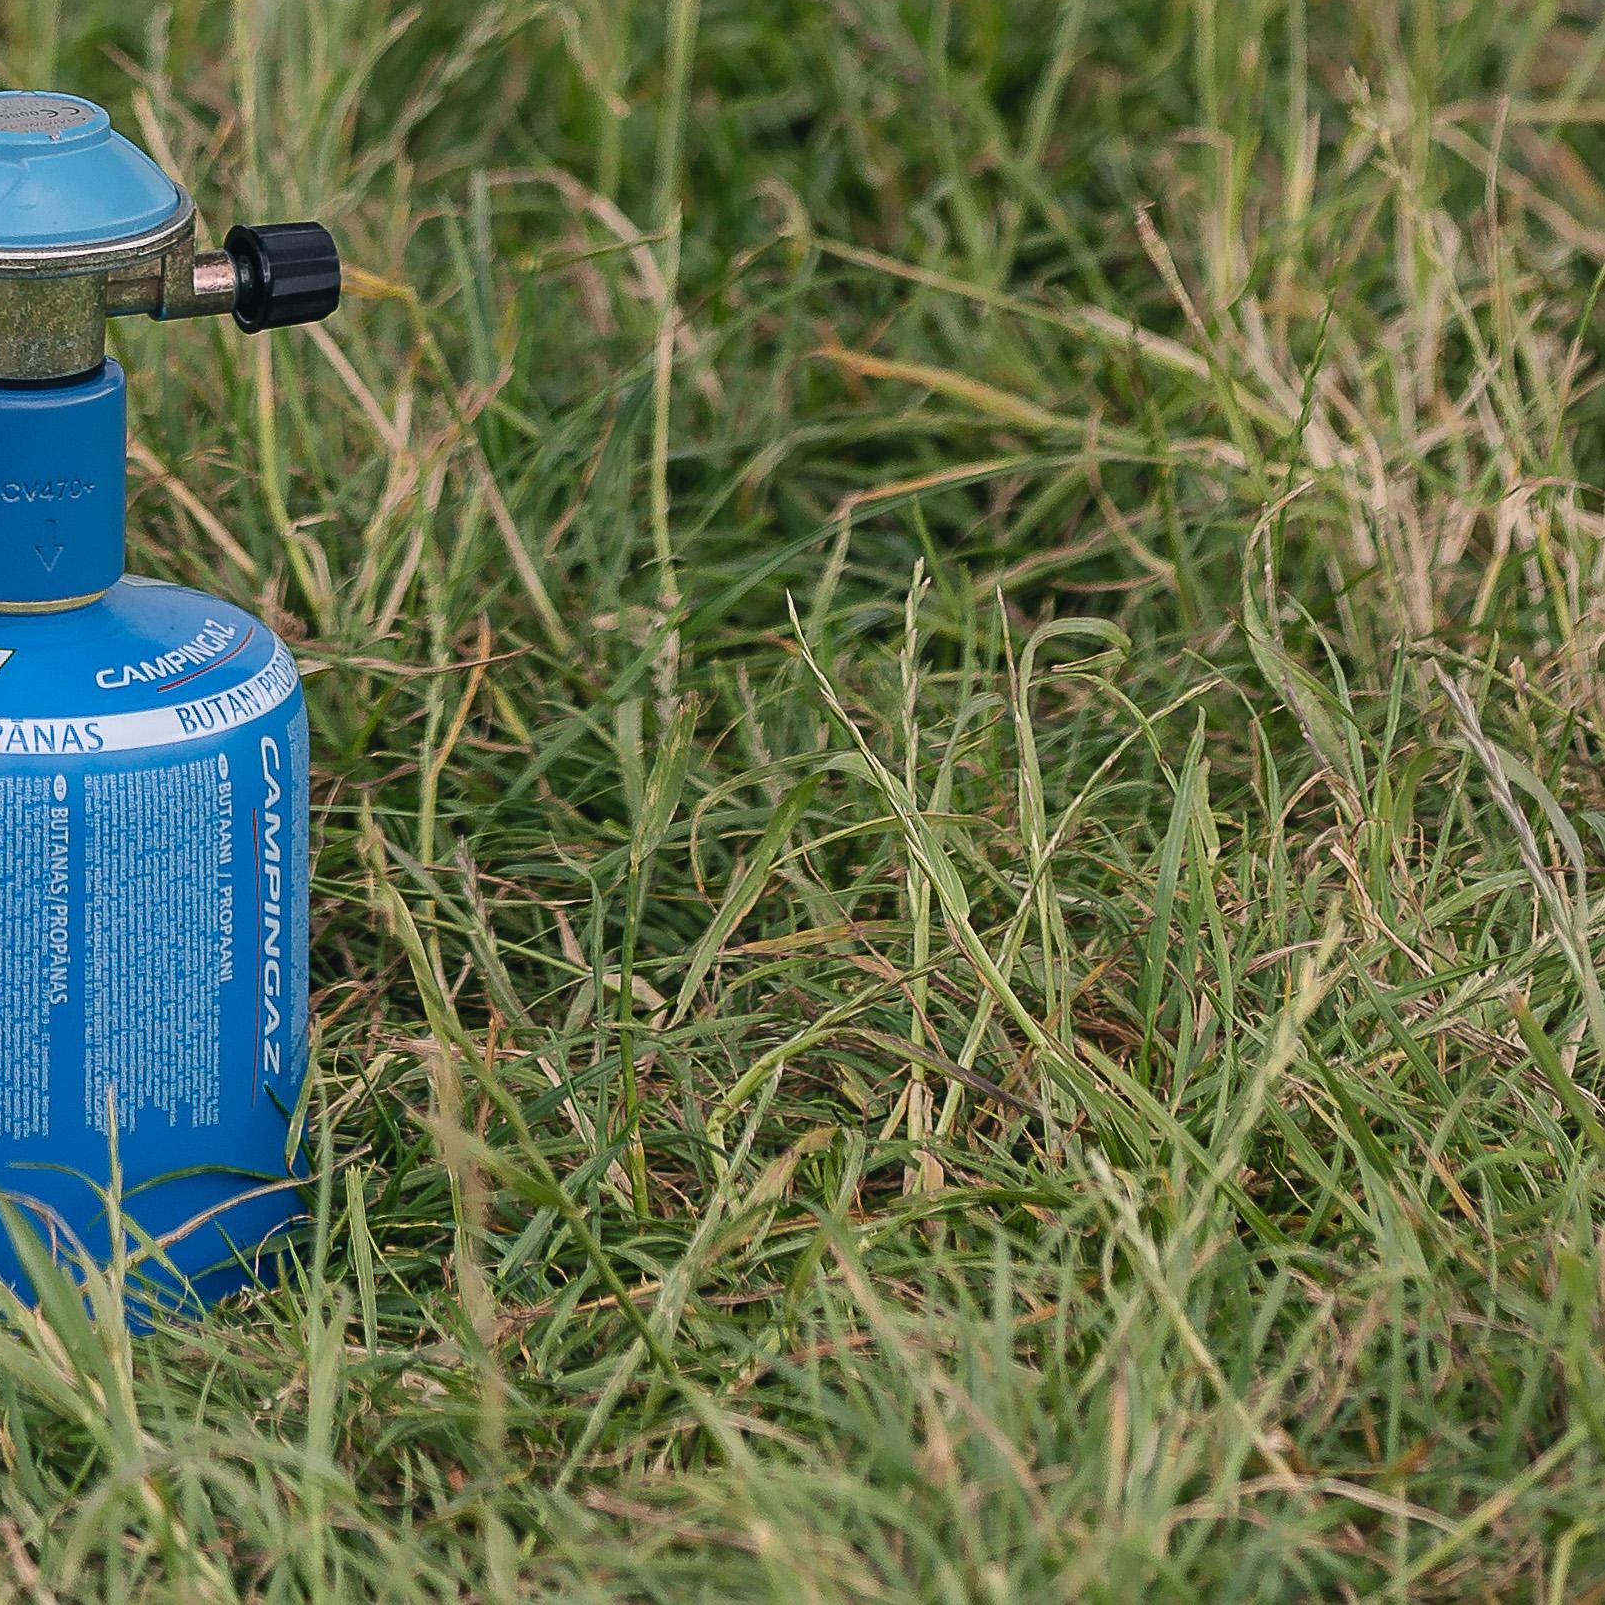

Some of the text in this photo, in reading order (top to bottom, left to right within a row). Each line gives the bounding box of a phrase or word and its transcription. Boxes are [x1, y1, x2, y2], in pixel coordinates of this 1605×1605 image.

[95, 617, 237, 689] CAMPINGAZ
[218, 781, 233, 865] BUTAANI
[218, 885, 234, 983] PROPAANI
[259, 736, 282, 1075] CAMPINGAZ
